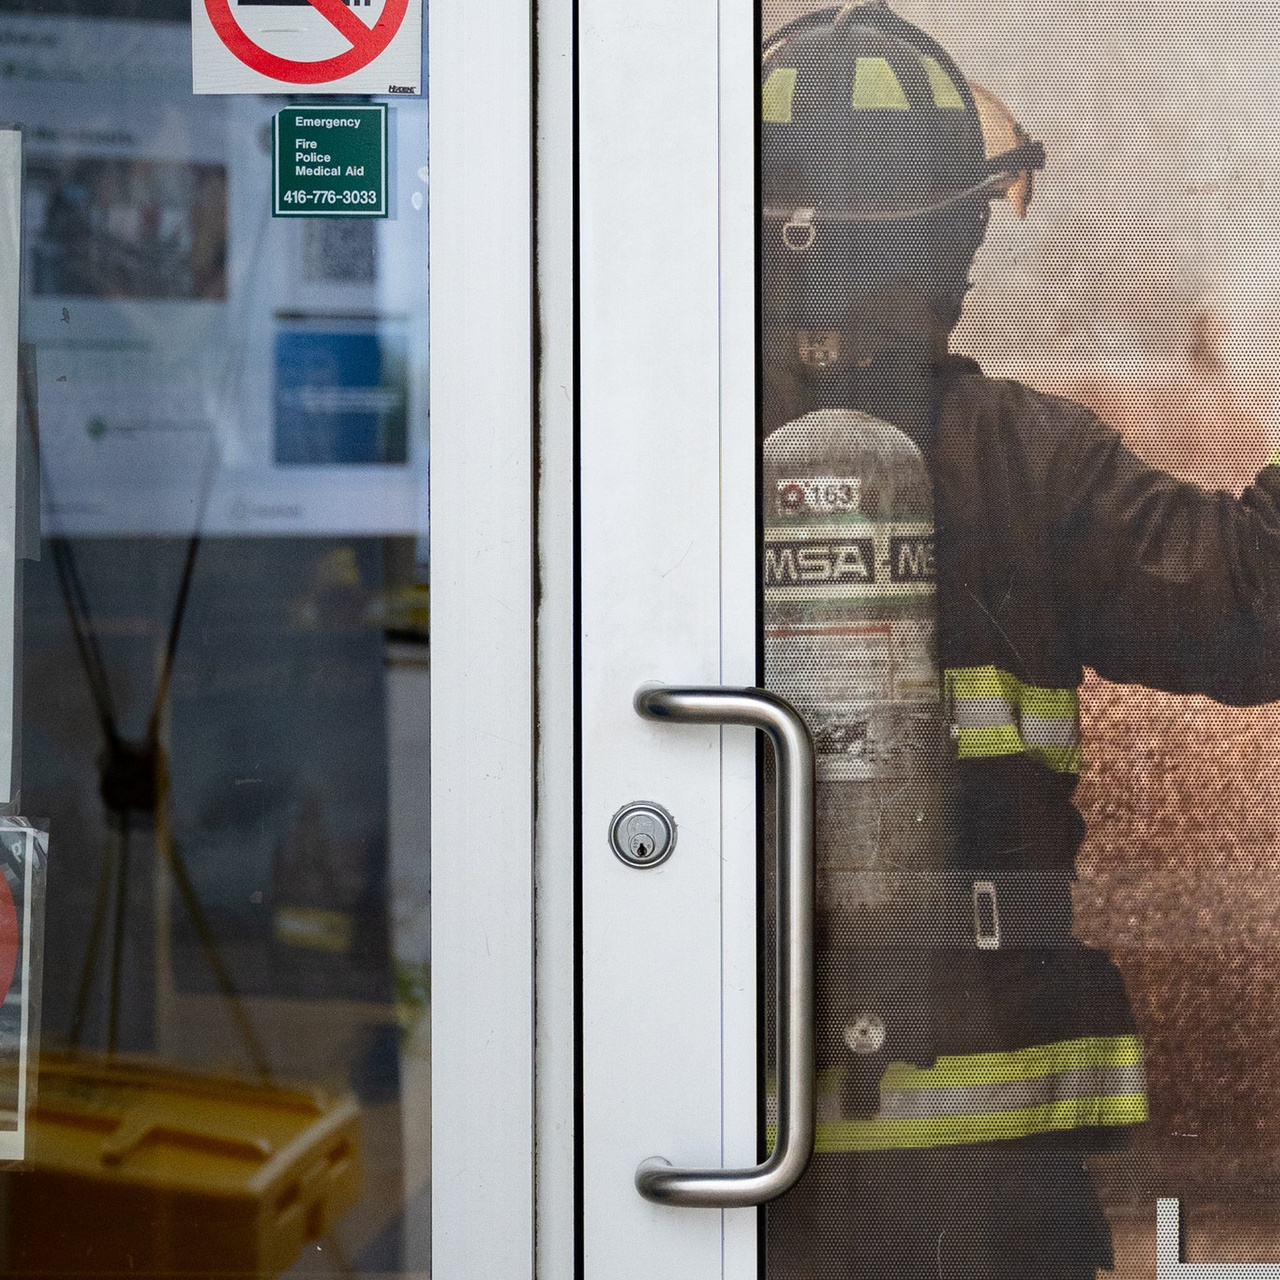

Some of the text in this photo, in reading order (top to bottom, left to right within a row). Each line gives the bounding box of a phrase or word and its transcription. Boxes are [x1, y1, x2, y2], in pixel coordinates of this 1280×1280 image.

[295, 116, 361, 129] Emergency
[295, 138, 318, 149] Fire
[295, 152, 331, 163] Police
[295, 165, 365, 176] Medical Aid
[283, 189, 377, 204] 416-776-3033
[765, 542, 870, 582] MSA
